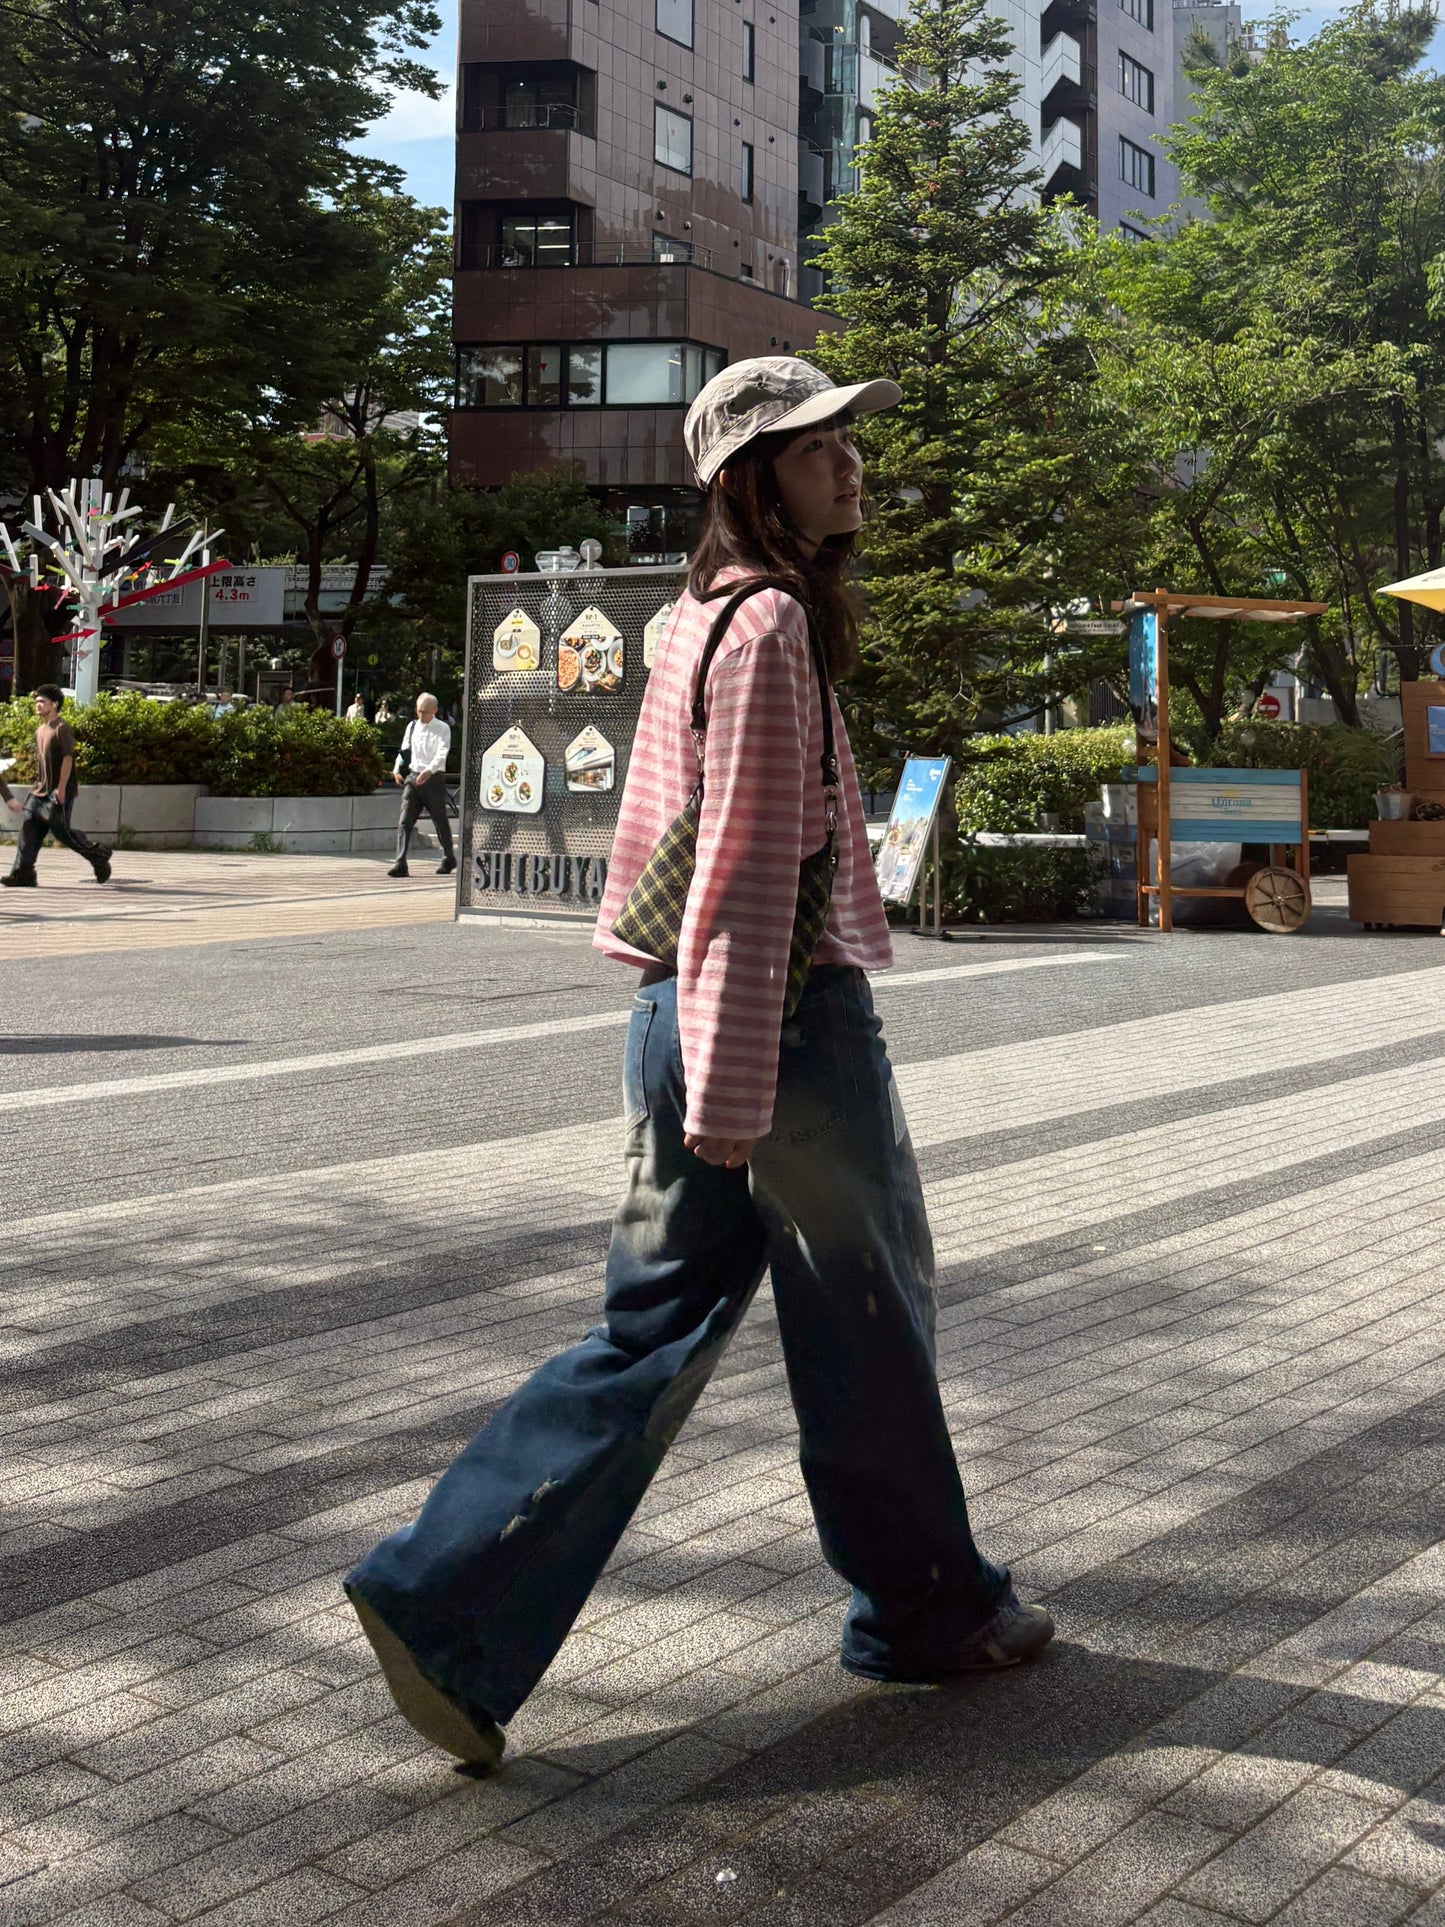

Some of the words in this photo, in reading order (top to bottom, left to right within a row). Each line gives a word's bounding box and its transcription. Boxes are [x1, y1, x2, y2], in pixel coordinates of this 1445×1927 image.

[210, 575, 257, 588] 上限高さ
[215, 588, 249, 600] 4.3m
[472, 852, 607, 900] SHIBUYA
